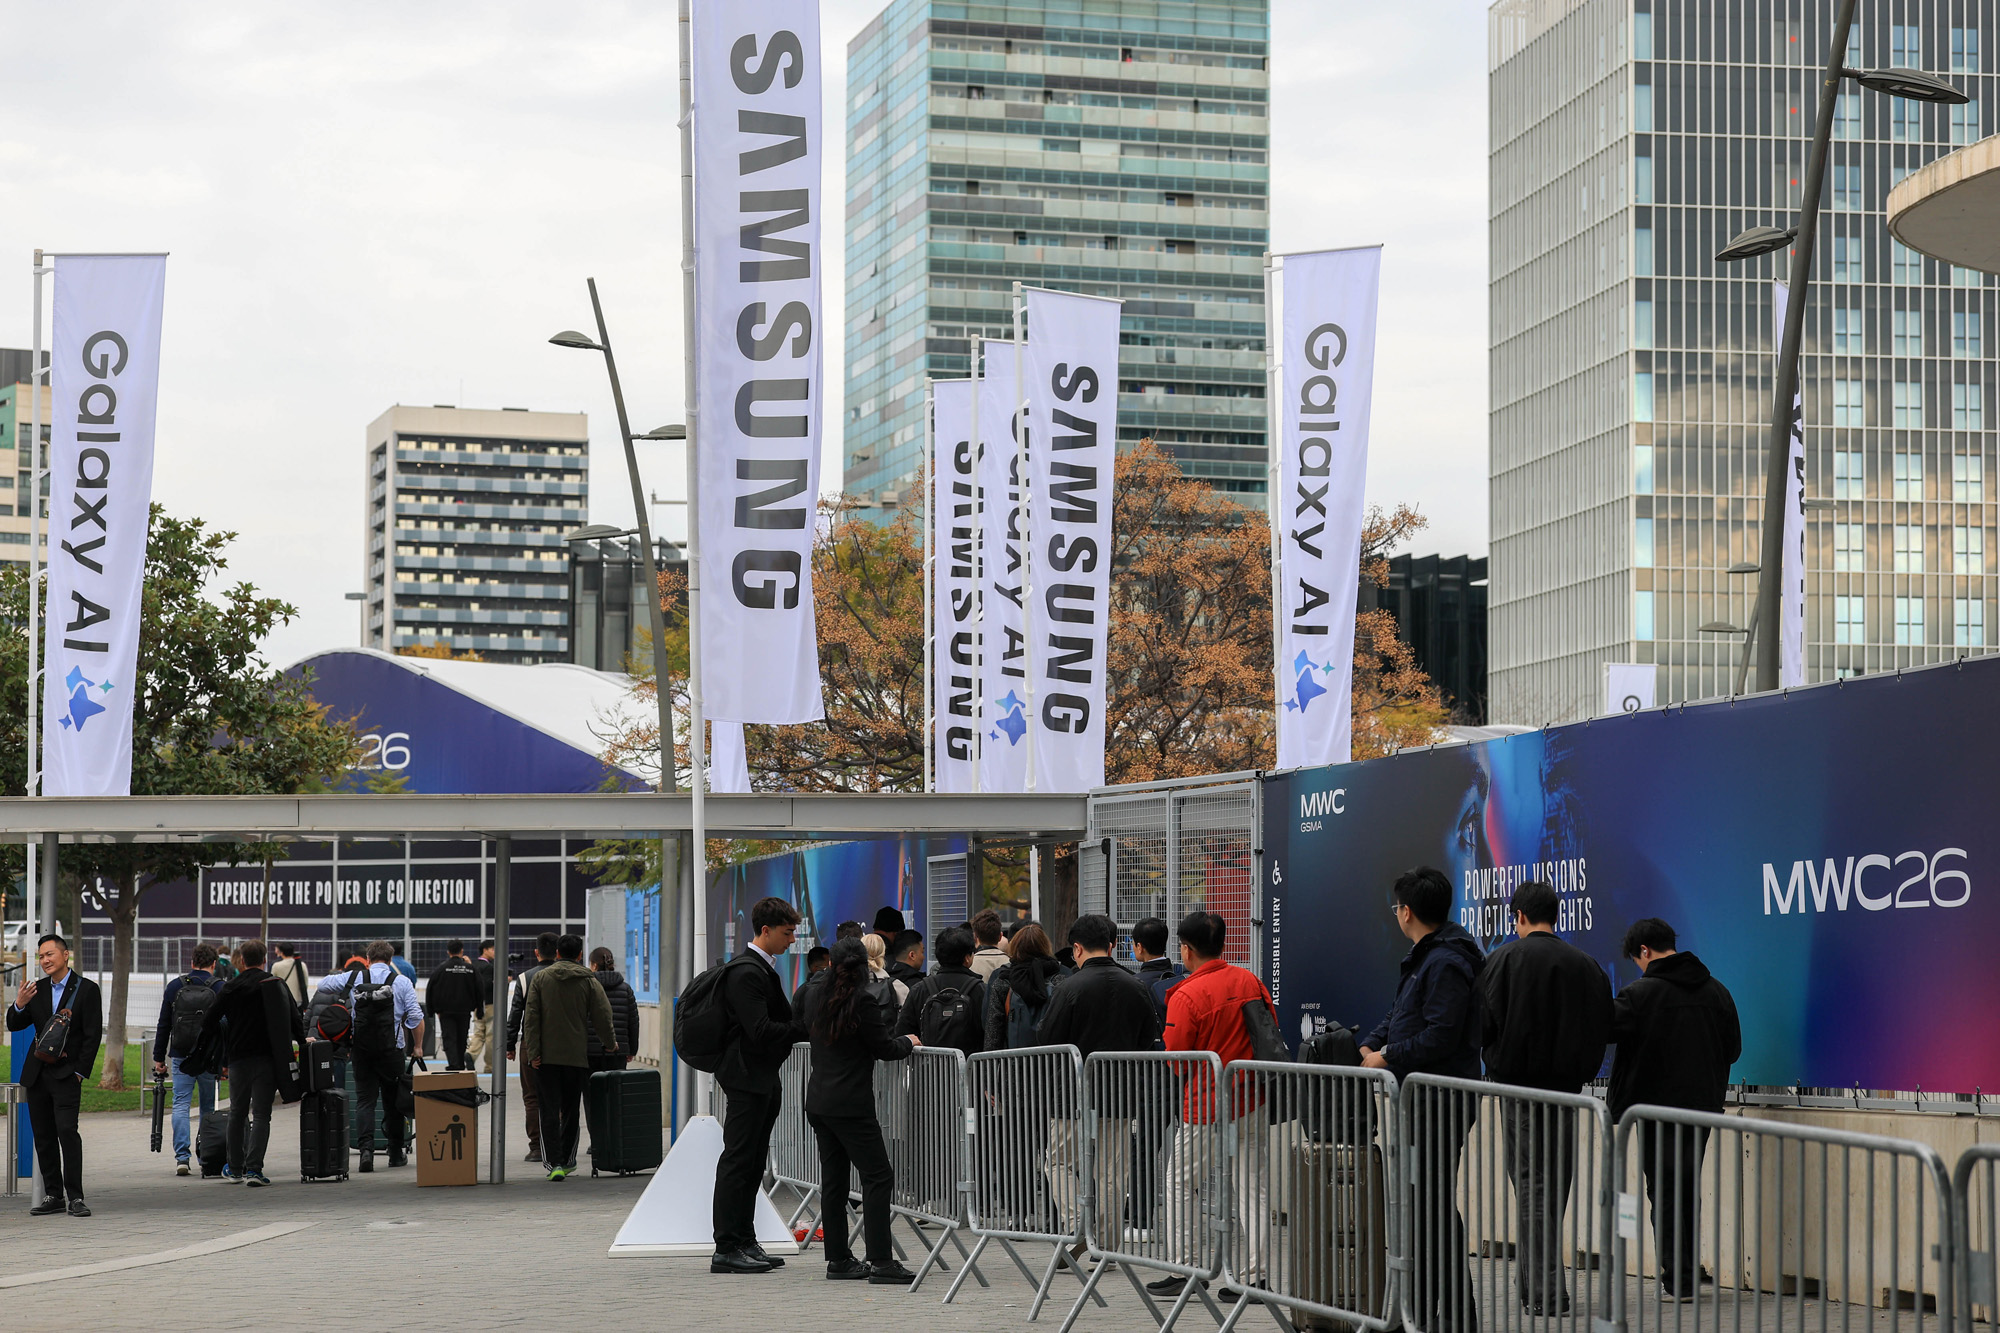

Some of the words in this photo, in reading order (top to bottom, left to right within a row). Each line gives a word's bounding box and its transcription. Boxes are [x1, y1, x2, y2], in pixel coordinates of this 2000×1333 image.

[730, 30, 811, 609] SAMSUNG
[61, 331, 128, 575] Galaxy
[1291, 323, 1347, 560] Galaxy
[1042, 363, 1099, 734] SAMSUNG
[64, 590, 110, 652] AI
[1292, 577, 1329, 635] AI
[1301, 789, 1345, 818] MWC
[1301, 821, 1323, 833] GSMA
[288, 881, 311, 905] THE
[366, 880, 381, 905] OF
[1533, 858, 1586, 893] VISIONS
[1763, 848, 1971, 915] MWC26
[1272, 897, 1281, 933] ENTRY
[1460, 904, 1517, 938] PRACTIC
[1554, 897, 1592, 932] GHTS
[1272, 937, 1280, 1006] ACCESSIBLE
